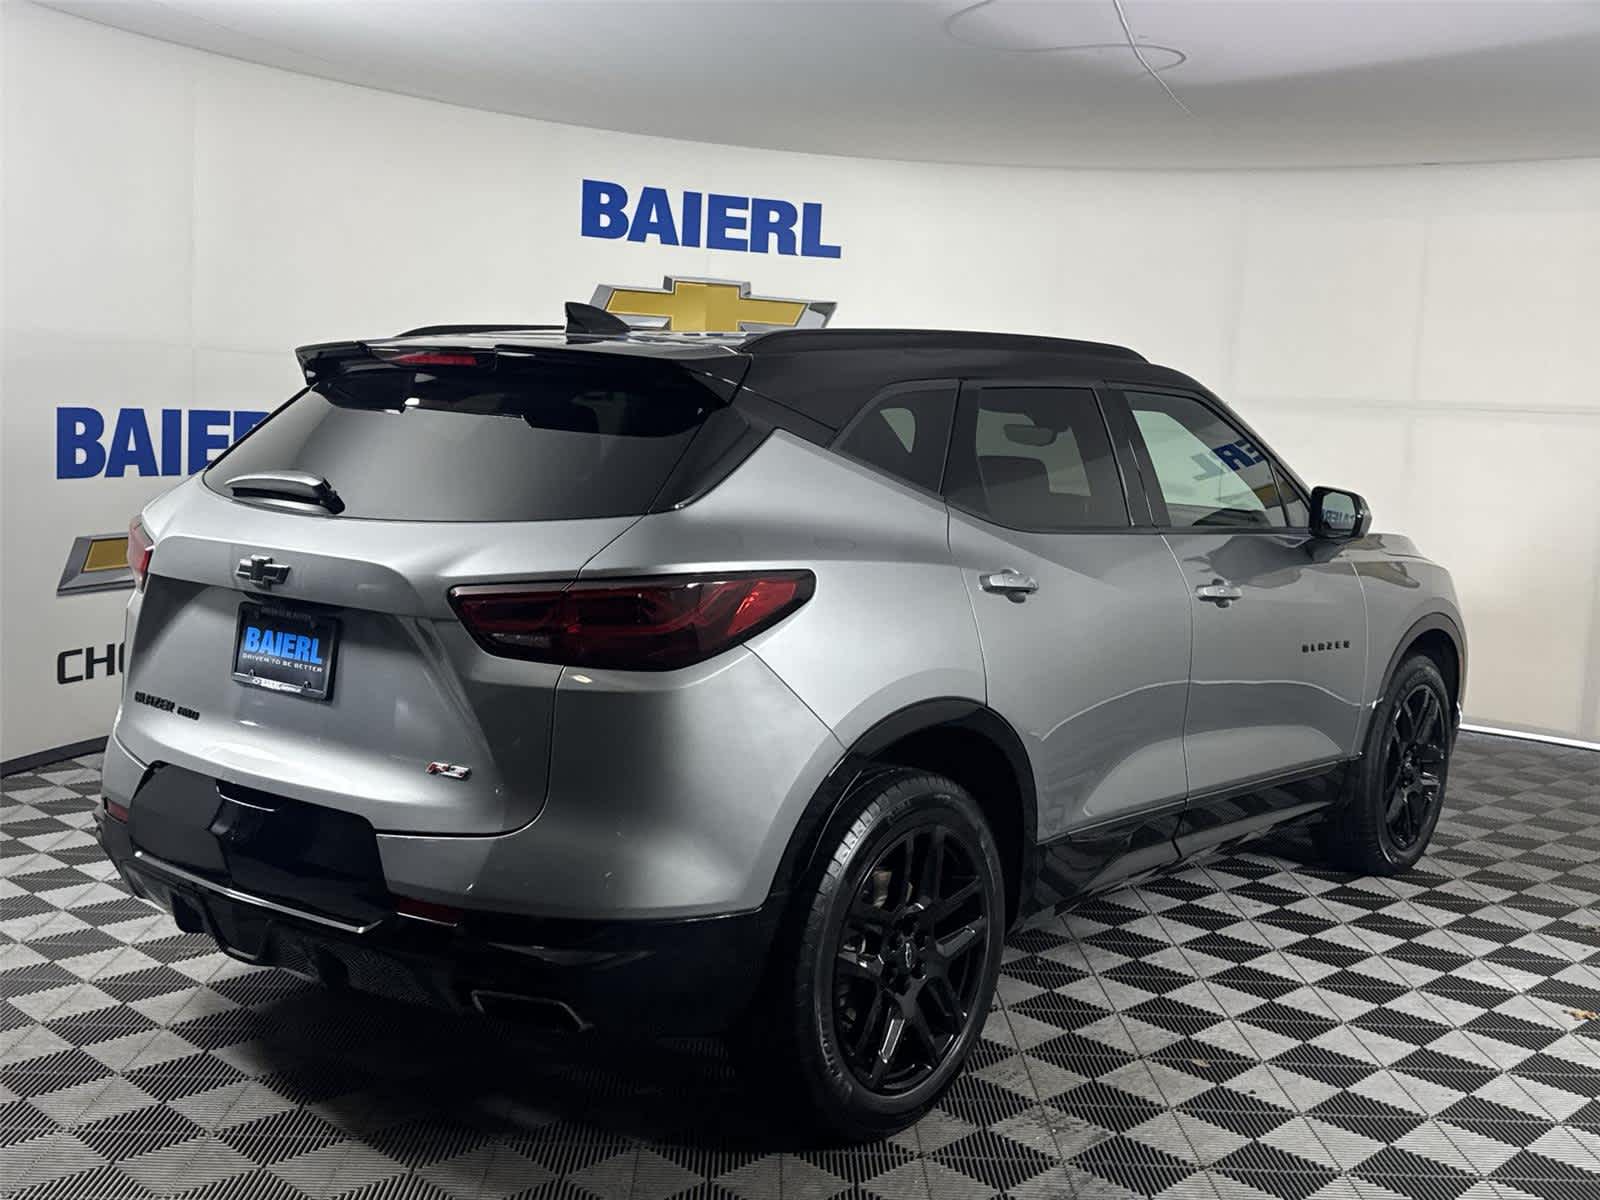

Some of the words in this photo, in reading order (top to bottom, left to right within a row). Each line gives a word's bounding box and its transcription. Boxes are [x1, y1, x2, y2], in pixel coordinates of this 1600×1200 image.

[581, 179, 841, 258] BAIERL
[243, 626, 322, 665] BAIERL
[1301, 640, 1350, 653] BLAZER
[242, 652, 269, 663] DRIVEN
[271, 657, 281, 665] TO
[282, 659, 292, 668] BE
[294, 663, 322, 673] BETTER
